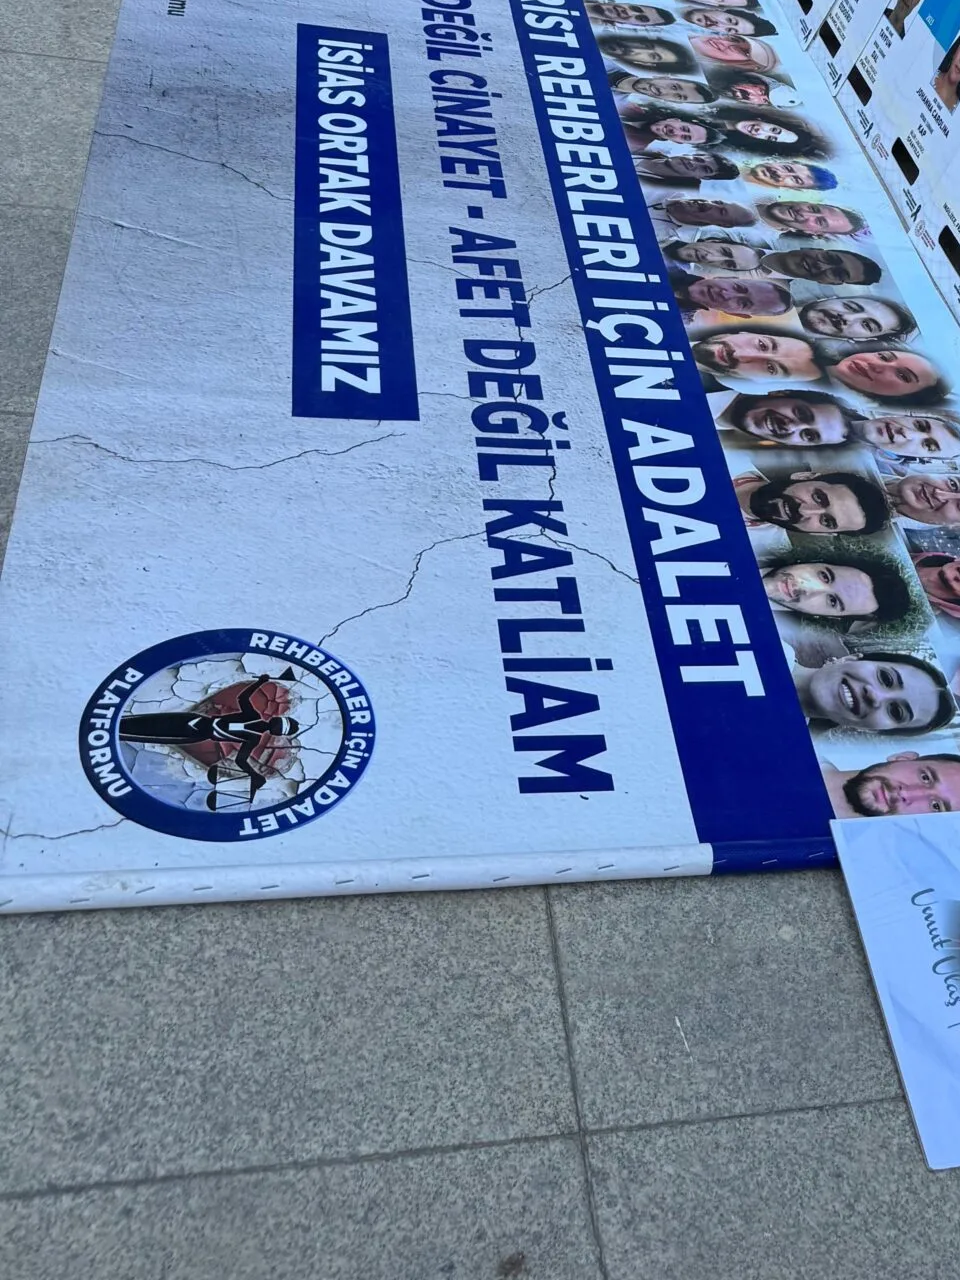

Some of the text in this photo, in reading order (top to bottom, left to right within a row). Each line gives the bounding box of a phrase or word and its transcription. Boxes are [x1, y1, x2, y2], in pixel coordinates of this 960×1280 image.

[429, 69, 508, 199] CİNAYET
[535, 54, 662, 284] REHBERLERİ
[318, 38, 382, 394] İSİAS ORTAK DAVAMIZ
[448, 226, 532, 328] AFET
[468, 206, 484, 219] -
[463, 338, 571, 482] DEĞİL
[585, 297, 685, 401] İÇİN
[621, 417, 766, 697] ADALET
[482, 499, 615, 794] KATLİAM
[87, 666, 145, 798] PLATFORMU
[239, 632, 374, 836] REHBERLER İÇİN ADALET
[911, 887, 952, 951] Umut
